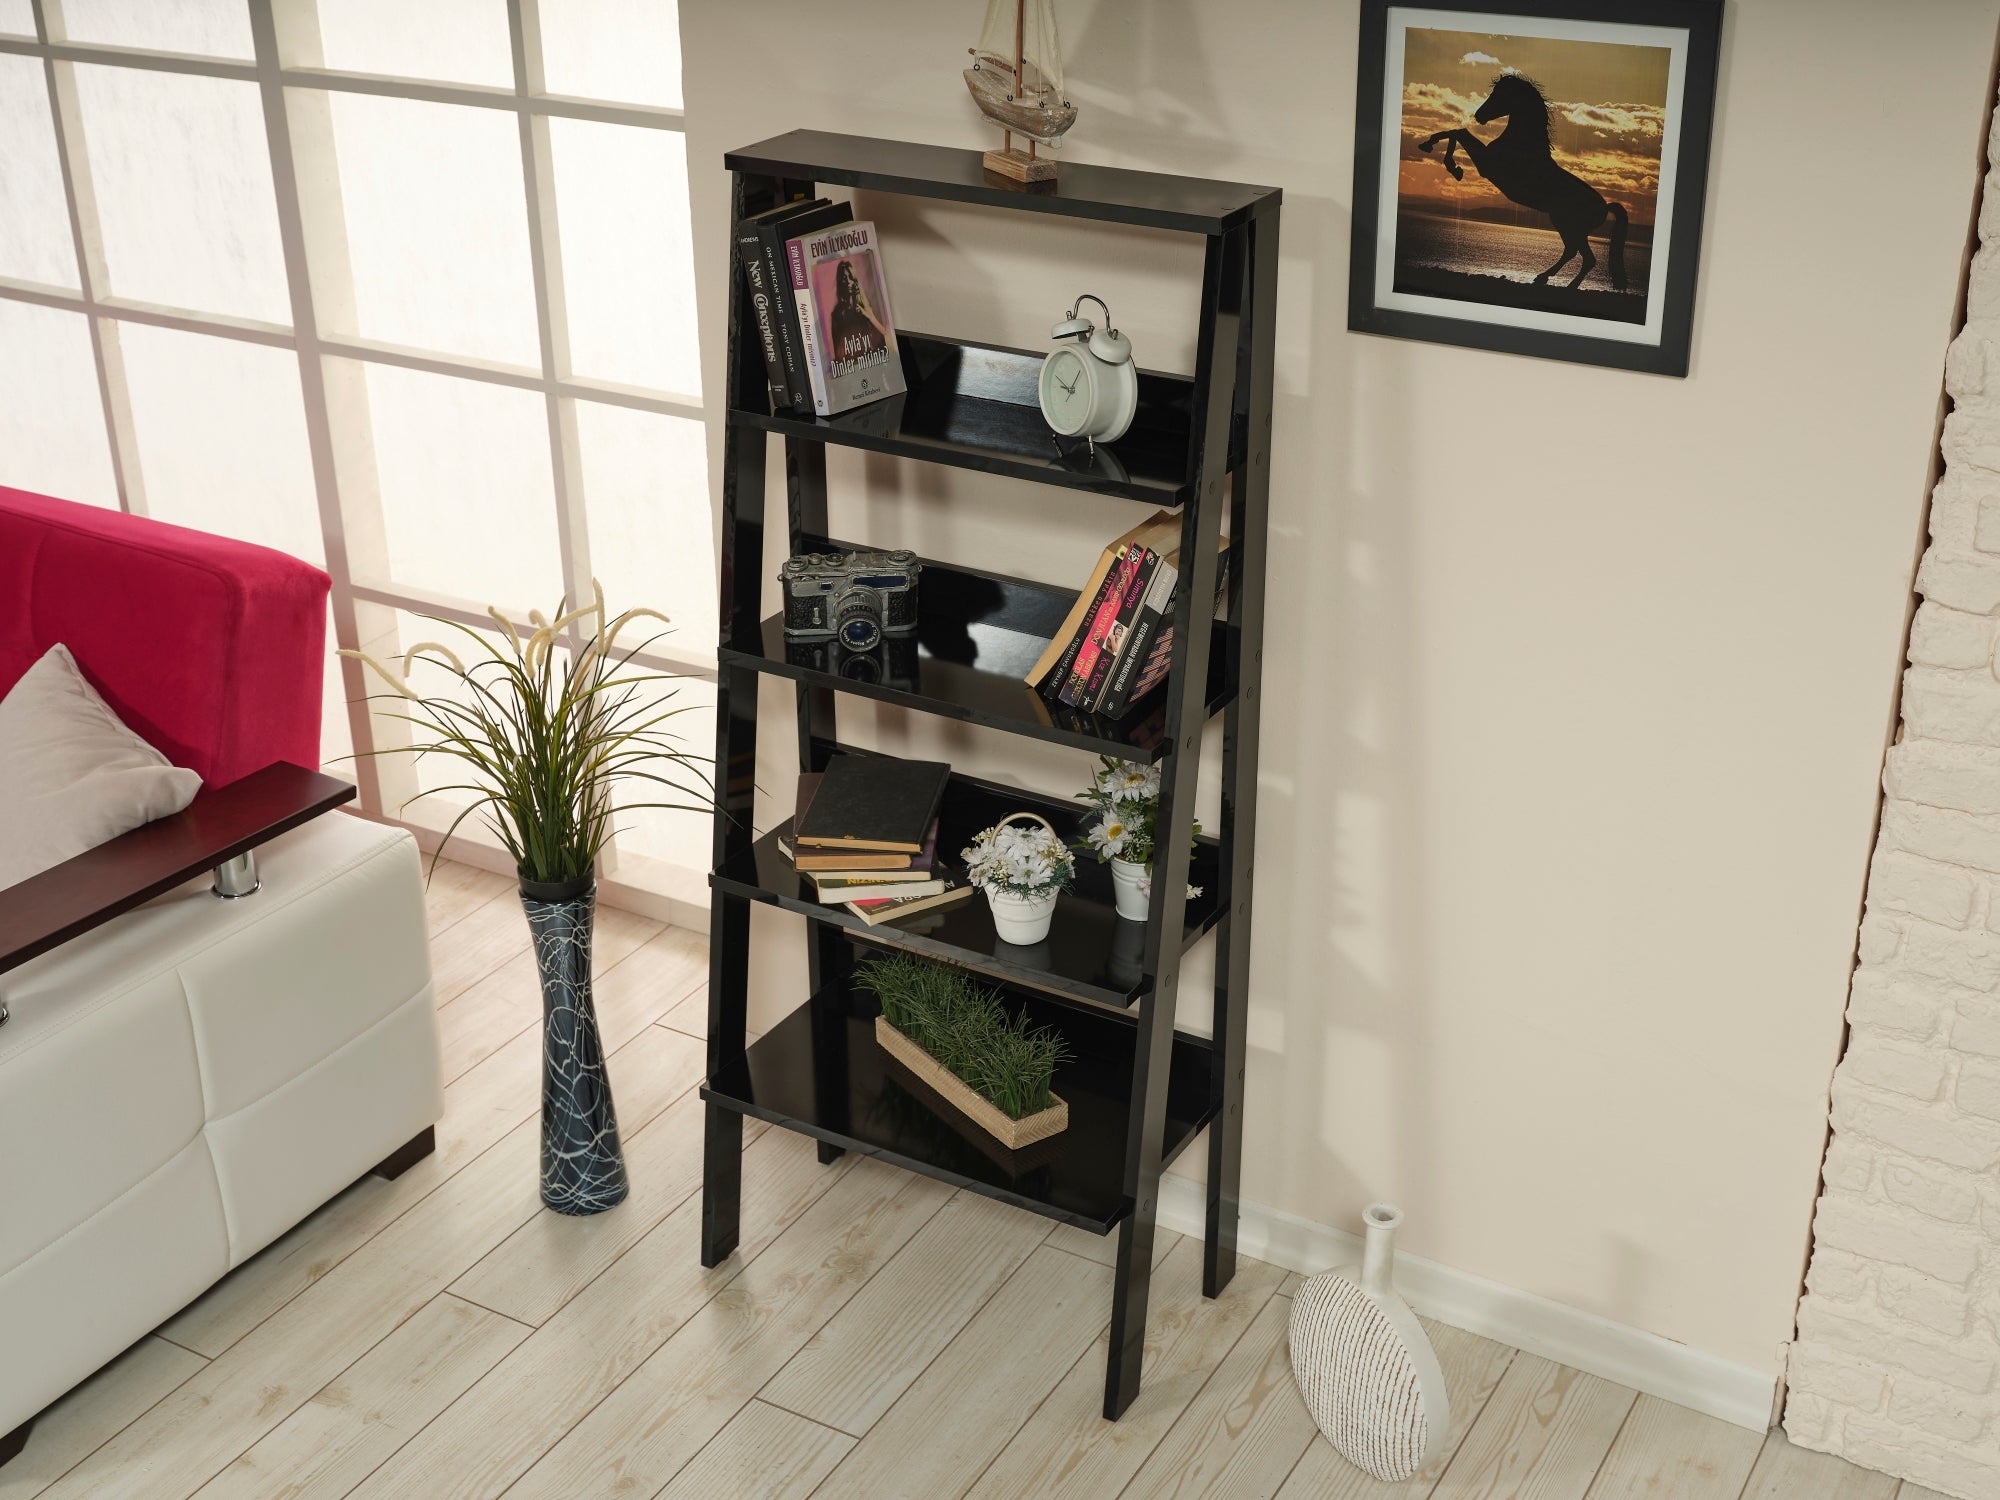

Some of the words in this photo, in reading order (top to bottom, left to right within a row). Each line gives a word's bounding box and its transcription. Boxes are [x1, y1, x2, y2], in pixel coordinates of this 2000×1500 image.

[766, 246, 773, 258] ON
[811, 238, 828, 258] EVİN
[828, 230, 868, 254] İLYASOĞLU
[747, 260, 763, 288] New
[769, 261, 780, 294] MEXICAN
[776, 295, 784, 314] TIME
[753, 293, 777, 362] Conceptions
[781, 323, 789, 344] TONY
[785, 346, 795, 372] COHAN
[844, 332, 871, 357] Ayla'yı
[831, 356, 855, 378] Dinler
[857, 345, 890, 371] misiniz?
[1084, 596, 1102, 627] uzakken
[1091, 626, 1102, 645] DON
[1051, 667, 1064, 687] ZEYNEP
